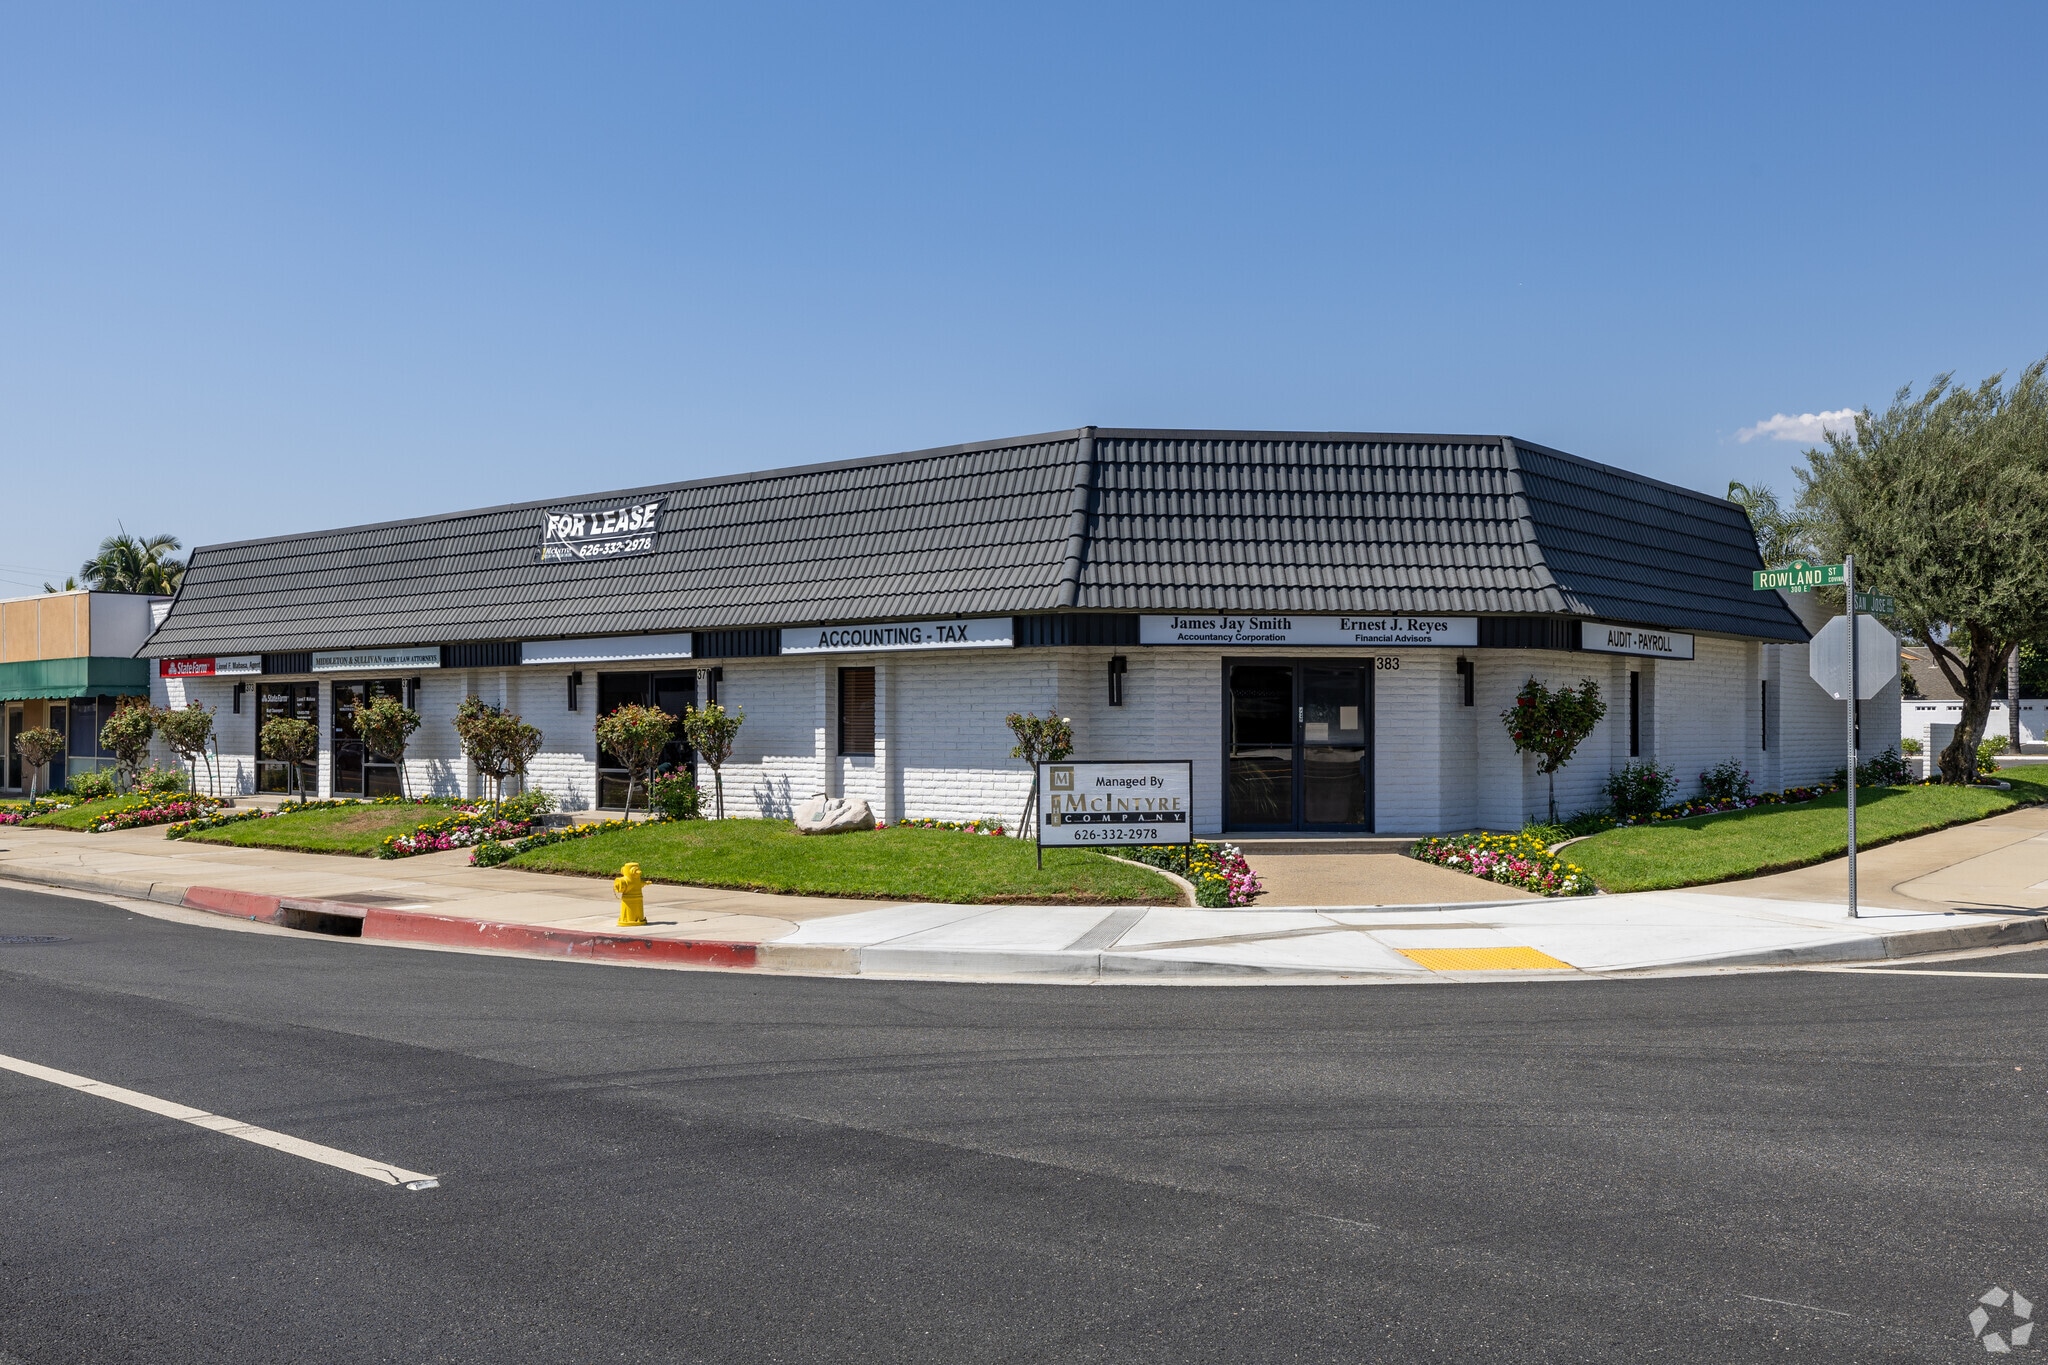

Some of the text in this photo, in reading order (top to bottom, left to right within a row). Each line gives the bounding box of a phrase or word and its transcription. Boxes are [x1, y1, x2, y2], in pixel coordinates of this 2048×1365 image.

[546, 503, 659, 539] FOR LEASE
[579, 537, 652, 557] 626-332-2978
[1759, 567, 1837, 588] ROWLAND ST
[1854, 594, 1886, 613] SAN JOSE
[1170, 616, 1292, 633] James Jay Smith
[1339, 617, 1448, 635] Ernest J. Reyes
[818, 627, 922, 648] ACCOUNTING
[936, 624, 968, 643] TAX
[1177, 633, 1286, 643] Accountancy Corporation
[1355, 634, 1432, 643] Financial Advisors
[1607, 629, 1633, 649] AUDIT
[1638, 633, 1673, 653] PAYROLL
[315, 656, 348, 665] MIDDLETON
[348, 656, 353, 665] &
[354, 655, 383, 664] SULLIVAN
[411, 654, 437, 662] ATTORNEYS
[1376, 657, 1400, 670] 383
[697, 668, 711, 680] 37
[1055, 772, 1068, 785] M
[1095, 776, 1164, 789] Managed By
[1065, 814, 1182, 822] COMPANY
[1074, 828, 1158, 840] 626-332-2978
